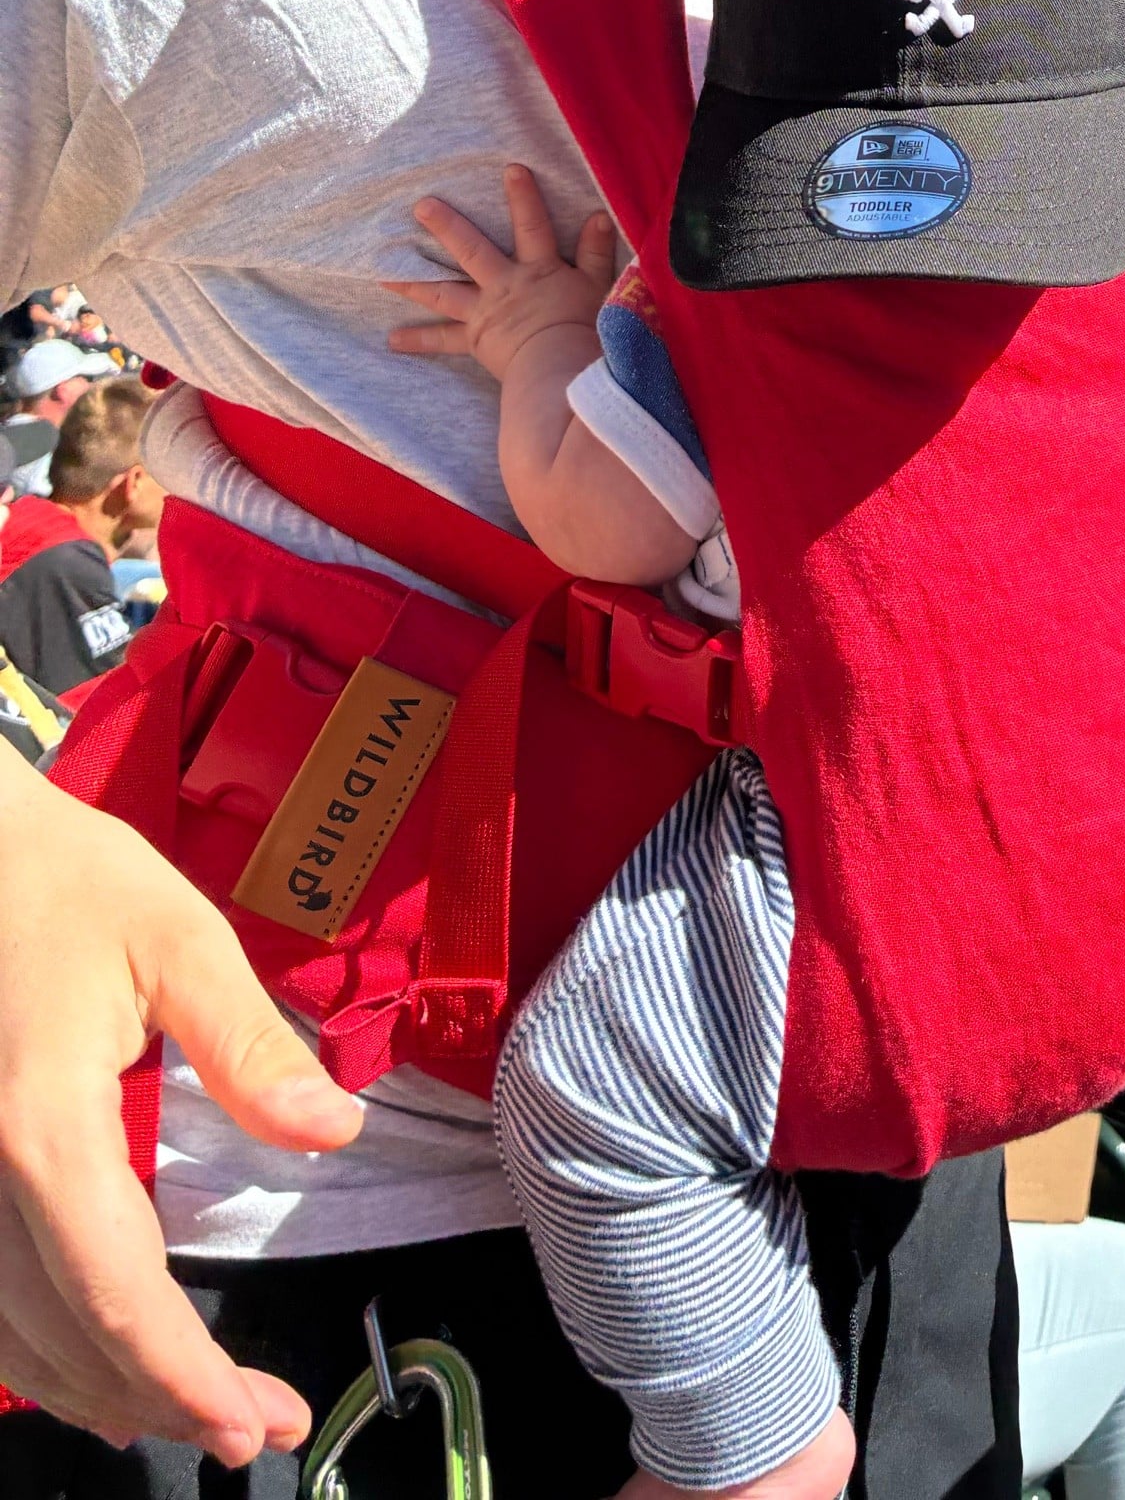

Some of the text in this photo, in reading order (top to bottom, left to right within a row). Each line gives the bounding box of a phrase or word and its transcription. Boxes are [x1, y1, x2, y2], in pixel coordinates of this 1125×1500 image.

[816, 169, 962, 194] 9TWENTY
[850, 201, 912, 213] TODDLER
[846, 213, 911, 222] ADJUSTABLE
[287, 697, 422, 897] WILDBIRD
